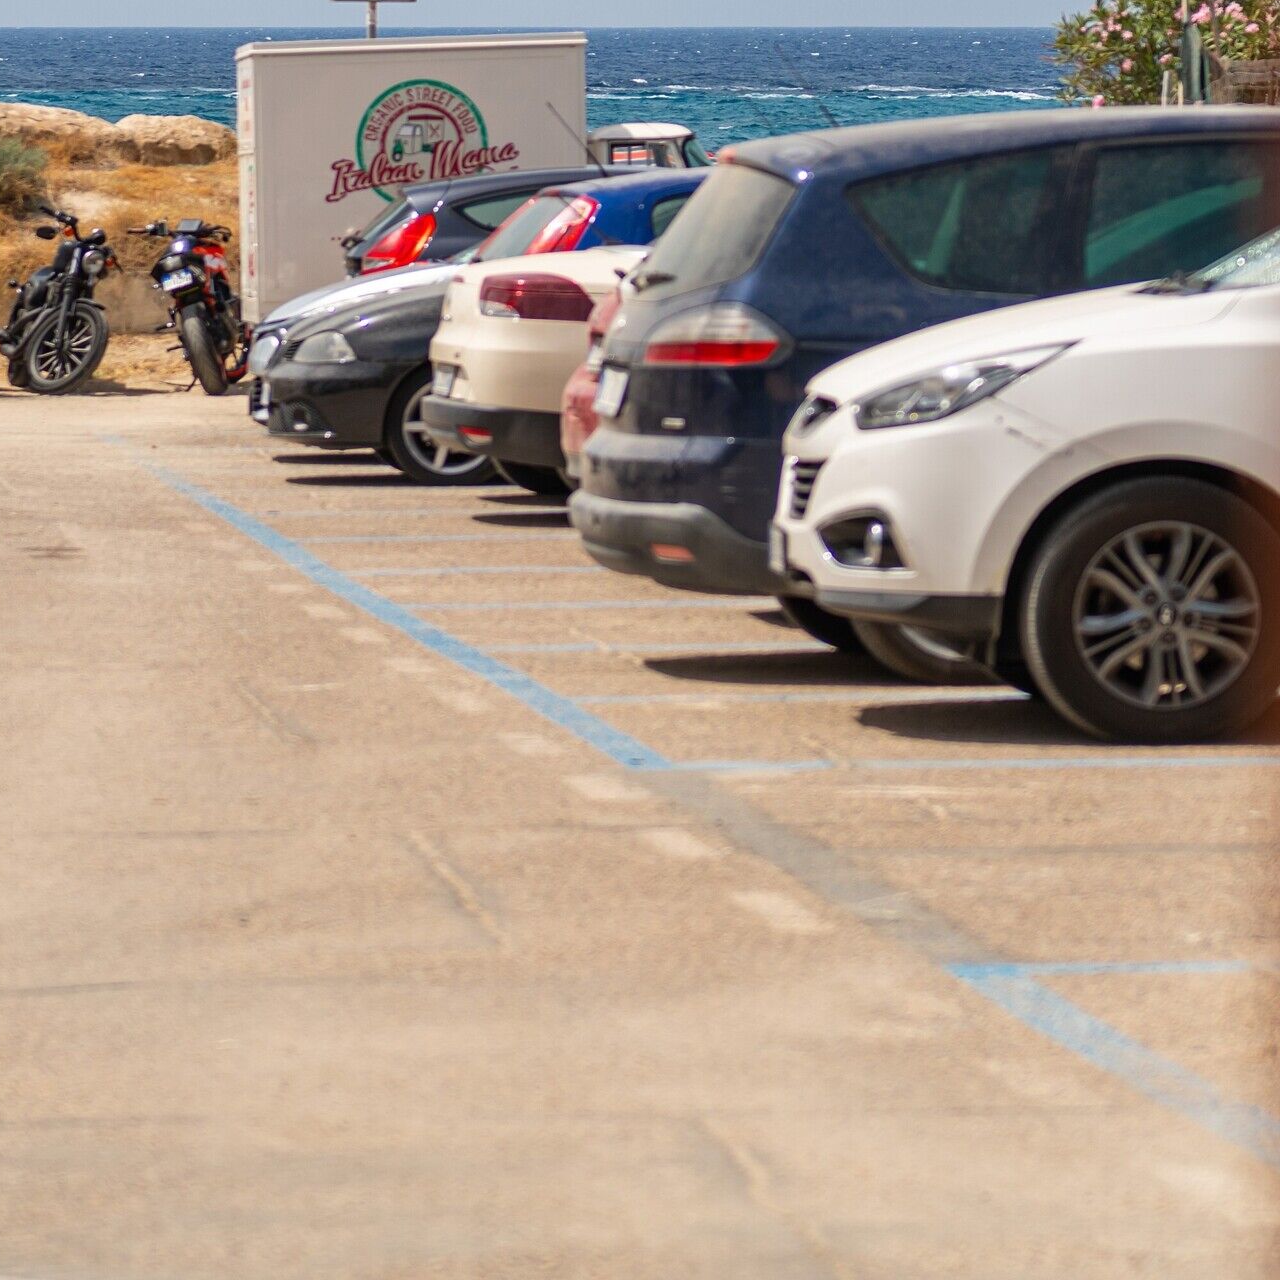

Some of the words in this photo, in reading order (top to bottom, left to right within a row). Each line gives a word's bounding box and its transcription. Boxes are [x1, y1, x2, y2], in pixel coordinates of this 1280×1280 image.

[365, 93, 405, 142] ORGANIC
[405, 87, 456, 108] STREET
[453, 102, 478, 134] FOOD
[325, 152, 425, 203] Italian
[429, 139, 520, 180] Mama
